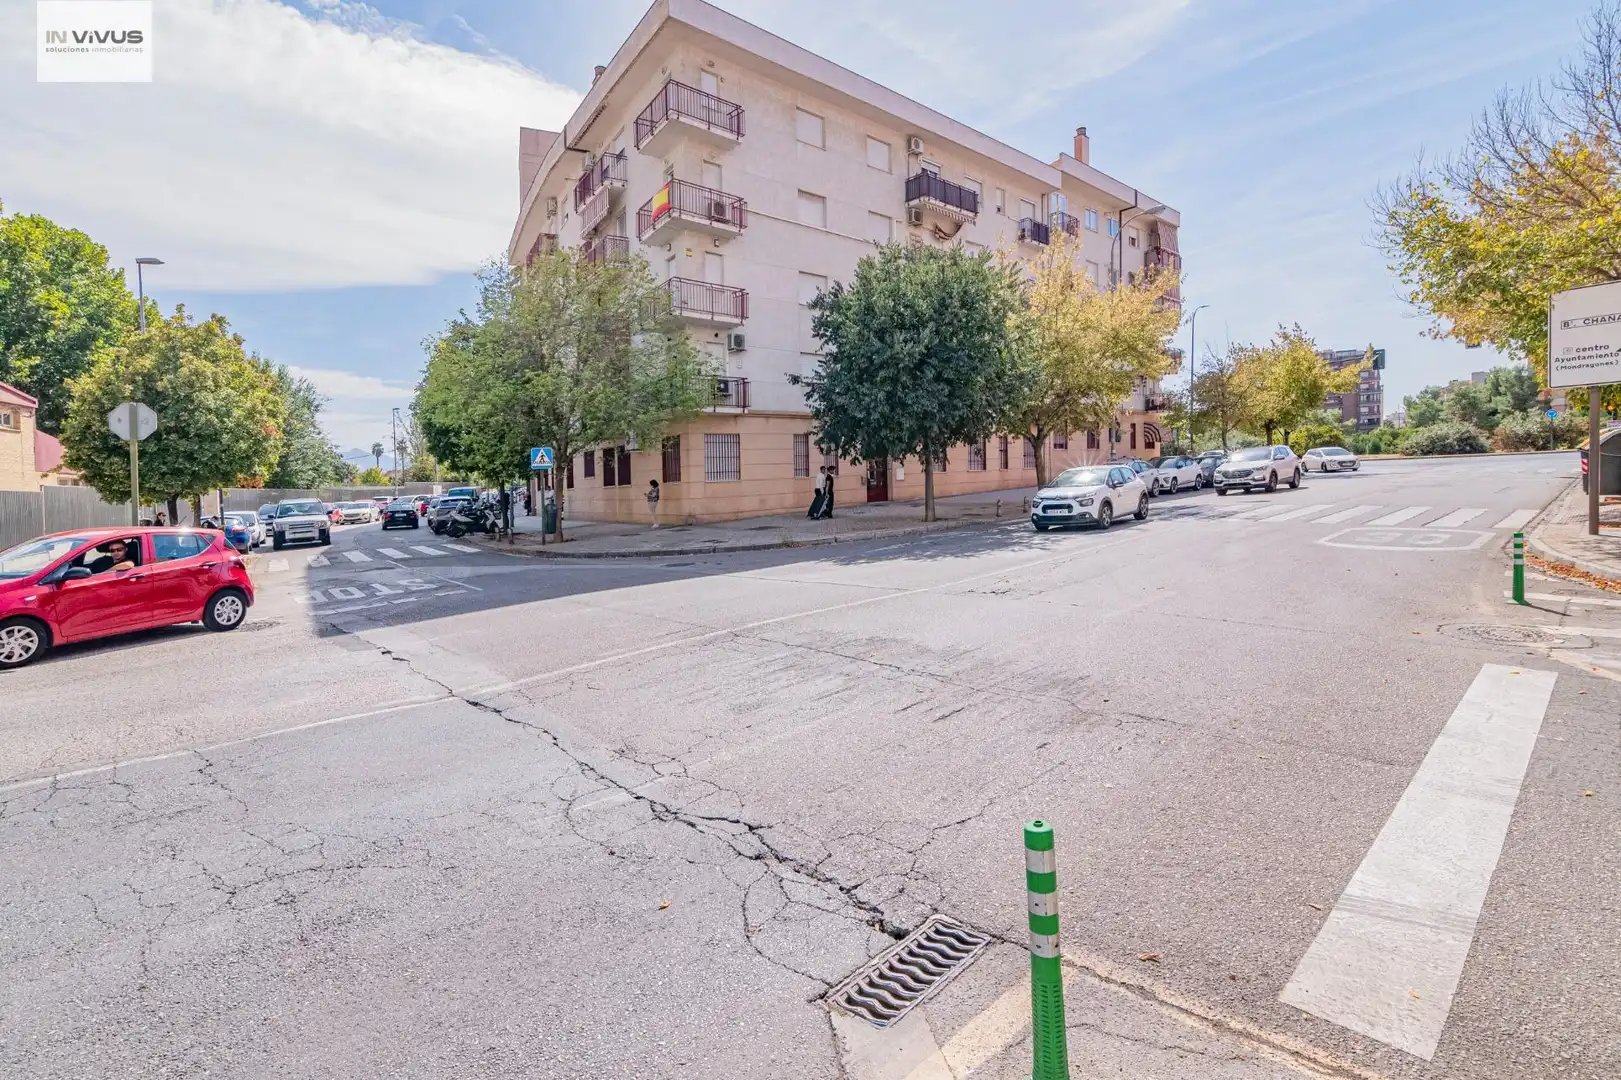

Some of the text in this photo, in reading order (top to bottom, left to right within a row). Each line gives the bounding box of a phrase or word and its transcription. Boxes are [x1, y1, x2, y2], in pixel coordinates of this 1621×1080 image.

[1575, 344, 1610, 353] centro
[1554, 352, 1620, 363] Ayuntamiento
[1555, 360, 1619, 371] (Mondragones)
